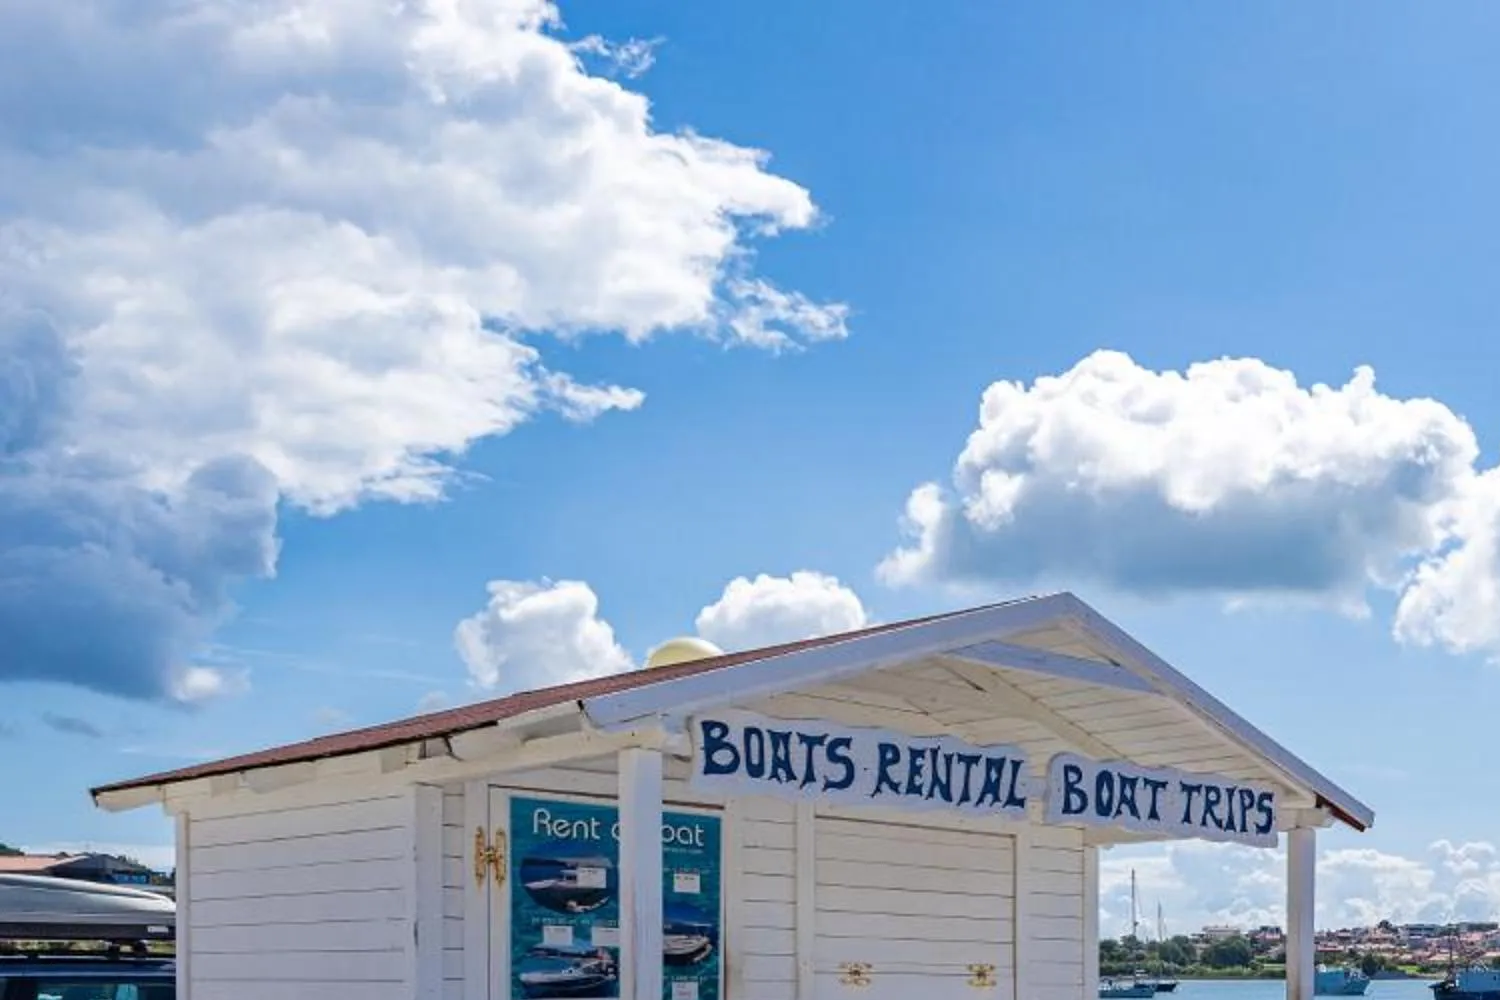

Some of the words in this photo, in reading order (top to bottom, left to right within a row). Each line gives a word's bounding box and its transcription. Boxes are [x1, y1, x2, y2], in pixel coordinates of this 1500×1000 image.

[700, 720, 855, 791] BOATS
[869, 742, 1027, 809] RENTAL
[1061, 764, 1169, 822] BOAT
[1179, 780, 1275, 835] TRIPS
[532, 807, 601, 840] Rent
[659, 823, 705, 847] oat
